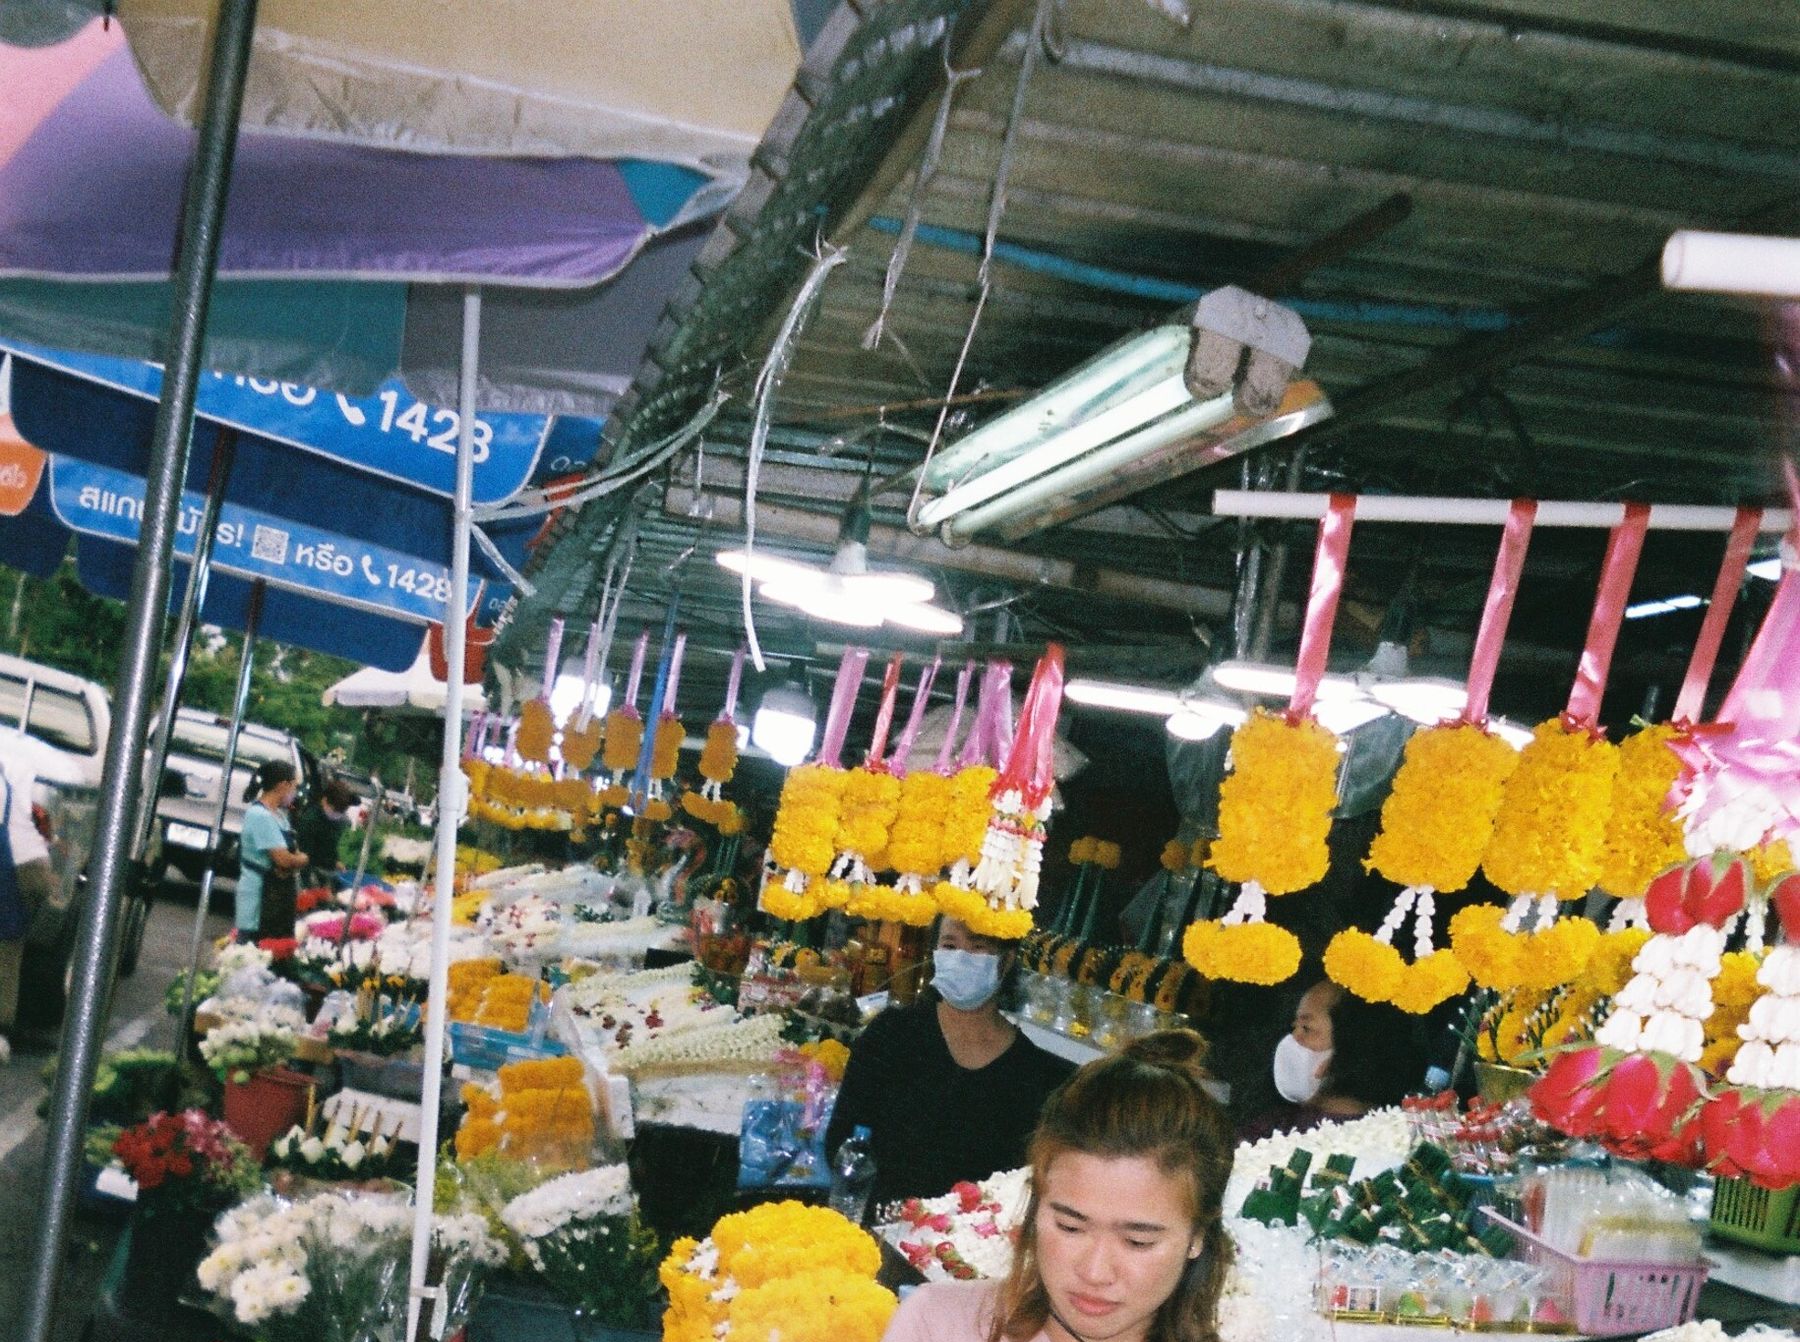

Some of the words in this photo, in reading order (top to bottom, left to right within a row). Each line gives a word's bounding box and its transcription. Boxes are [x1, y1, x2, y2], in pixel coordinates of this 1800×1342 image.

[379, 390, 494, 464] 1428
[295, 543, 353, 577] หรือ
[388, 564, 452, 603] 1428
